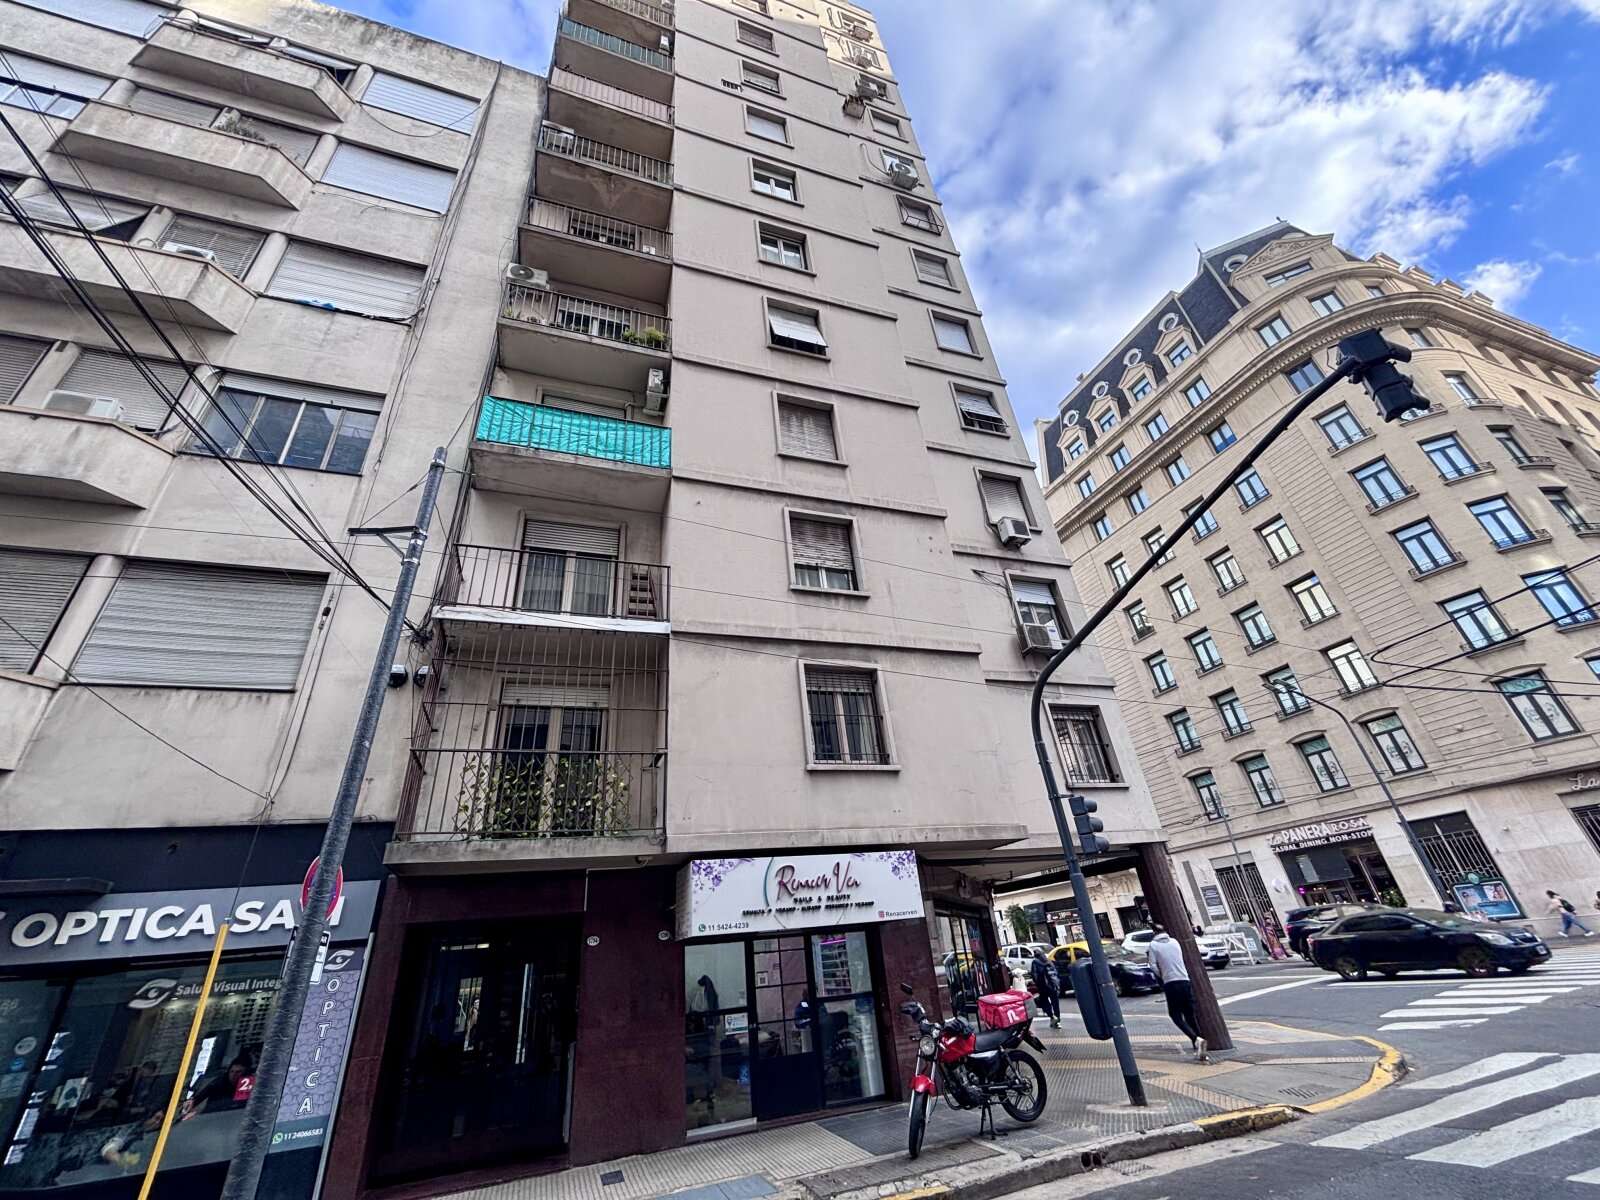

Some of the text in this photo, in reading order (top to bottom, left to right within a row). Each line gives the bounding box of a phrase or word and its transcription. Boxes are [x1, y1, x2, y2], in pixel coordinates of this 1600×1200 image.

[1272, 829, 1373, 853] CASUAL DINING NON-STOP
[1281, 822, 1332, 843] PANERA
[1330, 818, 1368, 832] ROSA
[775, 861, 861, 900] Renacer Ven
[794, 896, 813, 904] NAILS
[11, 895, 345, 947] OPTICA SAI
[717, 922, 750, 931] 5424-4239
[175, 978, 283, 996] Salu Visual Integ
[296, 976, 341, 1115] OPTICA
